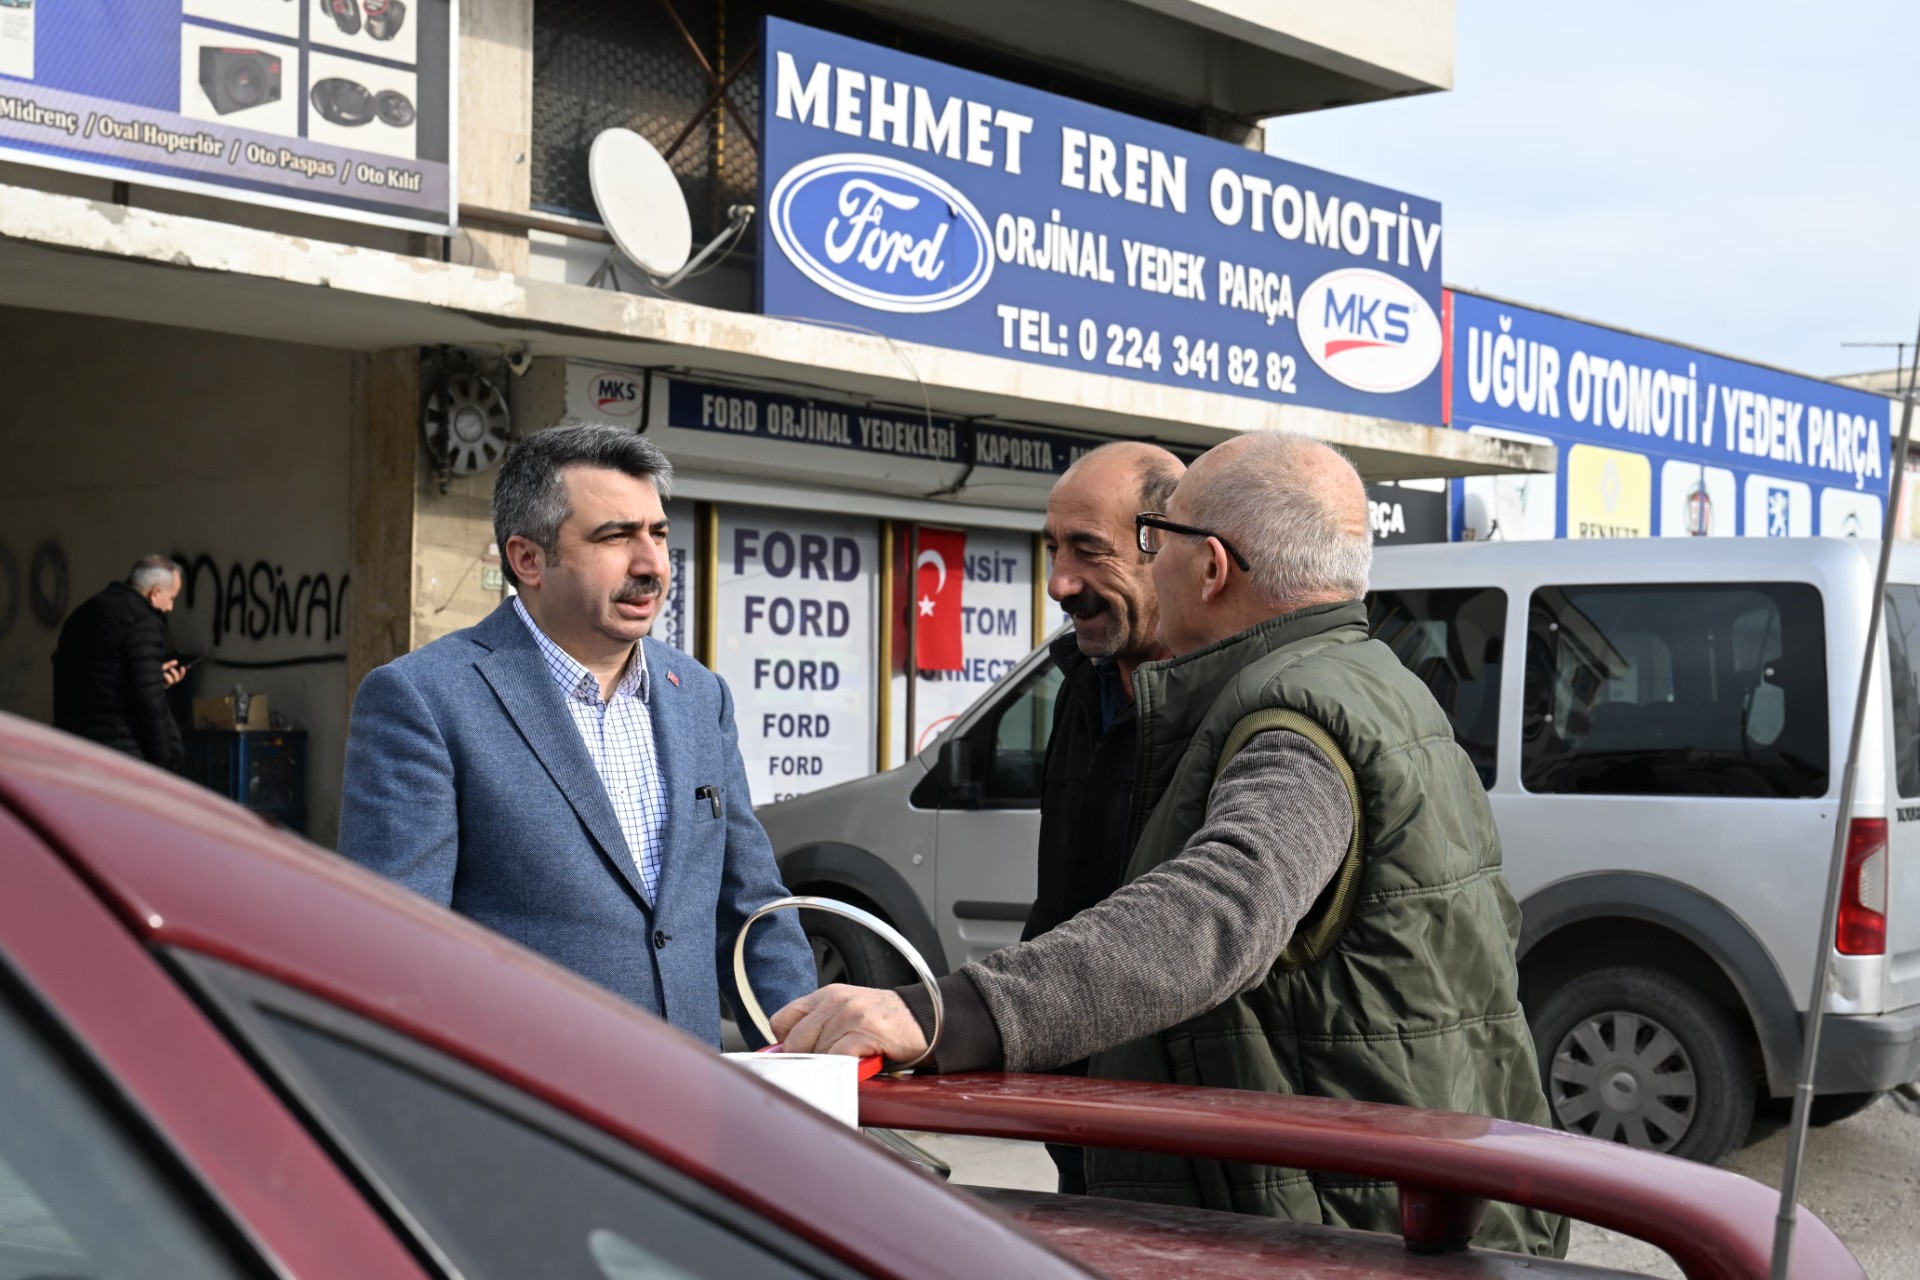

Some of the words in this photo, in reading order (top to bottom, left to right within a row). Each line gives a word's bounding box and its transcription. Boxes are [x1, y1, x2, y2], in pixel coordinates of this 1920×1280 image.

[99, 116, 140, 142] Oval
[143, 123, 223, 157] Hoperlör
[246, 142, 277, 167] Oto
[279, 149, 335, 179] Paspas
[356, 163, 385, 186] Oto
[775, 50, 1033, 175] MEHMET
[1061, 126, 1188, 214] EREN
[1210, 167, 1441, 273] OTOMOTİV
[824, 178, 949, 282] Ford
[995, 208, 1115, 284] ORJİNAL
[1122, 239, 1206, 302] YEDEK
[1218, 260, 1295, 326] PARÇA
[1324, 287, 1411, 345] MKS
[997, 304, 1069, 358] TEL:
[1078, 318, 1098, 361] 0
[1106, 323, 1161, 372] 224
[1172, 335, 1219, 382] 341
[1227, 345, 1260, 389] 82
[1266, 352, 1297, 394] 82
[598, 378, 637, 401] MKS
[1467, 314, 1561, 419] UĞUR
[1721, 385, 1804, 465] YEDEK
[1806, 405, 1882, 490] PARÇA
[702, 393, 758, 432] FORD
[767, 402, 852, 445] ORJİNAL
[858, 415, 957, 459] YEDEKLERİ
[976, 432, 1054, 470] KAPORTA
[1367, 499, 1406, 538] RÇA
[733, 528, 862, 583] FORD
[963, 551, 1017, 584] NSİT
[744, 595, 851, 638] FORD
[961, 606, 1017, 636] TOM
[753, 658, 840, 692] FORD
[762, 713, 830, 738] FORD
[768, 755, 823, 776] FORD
